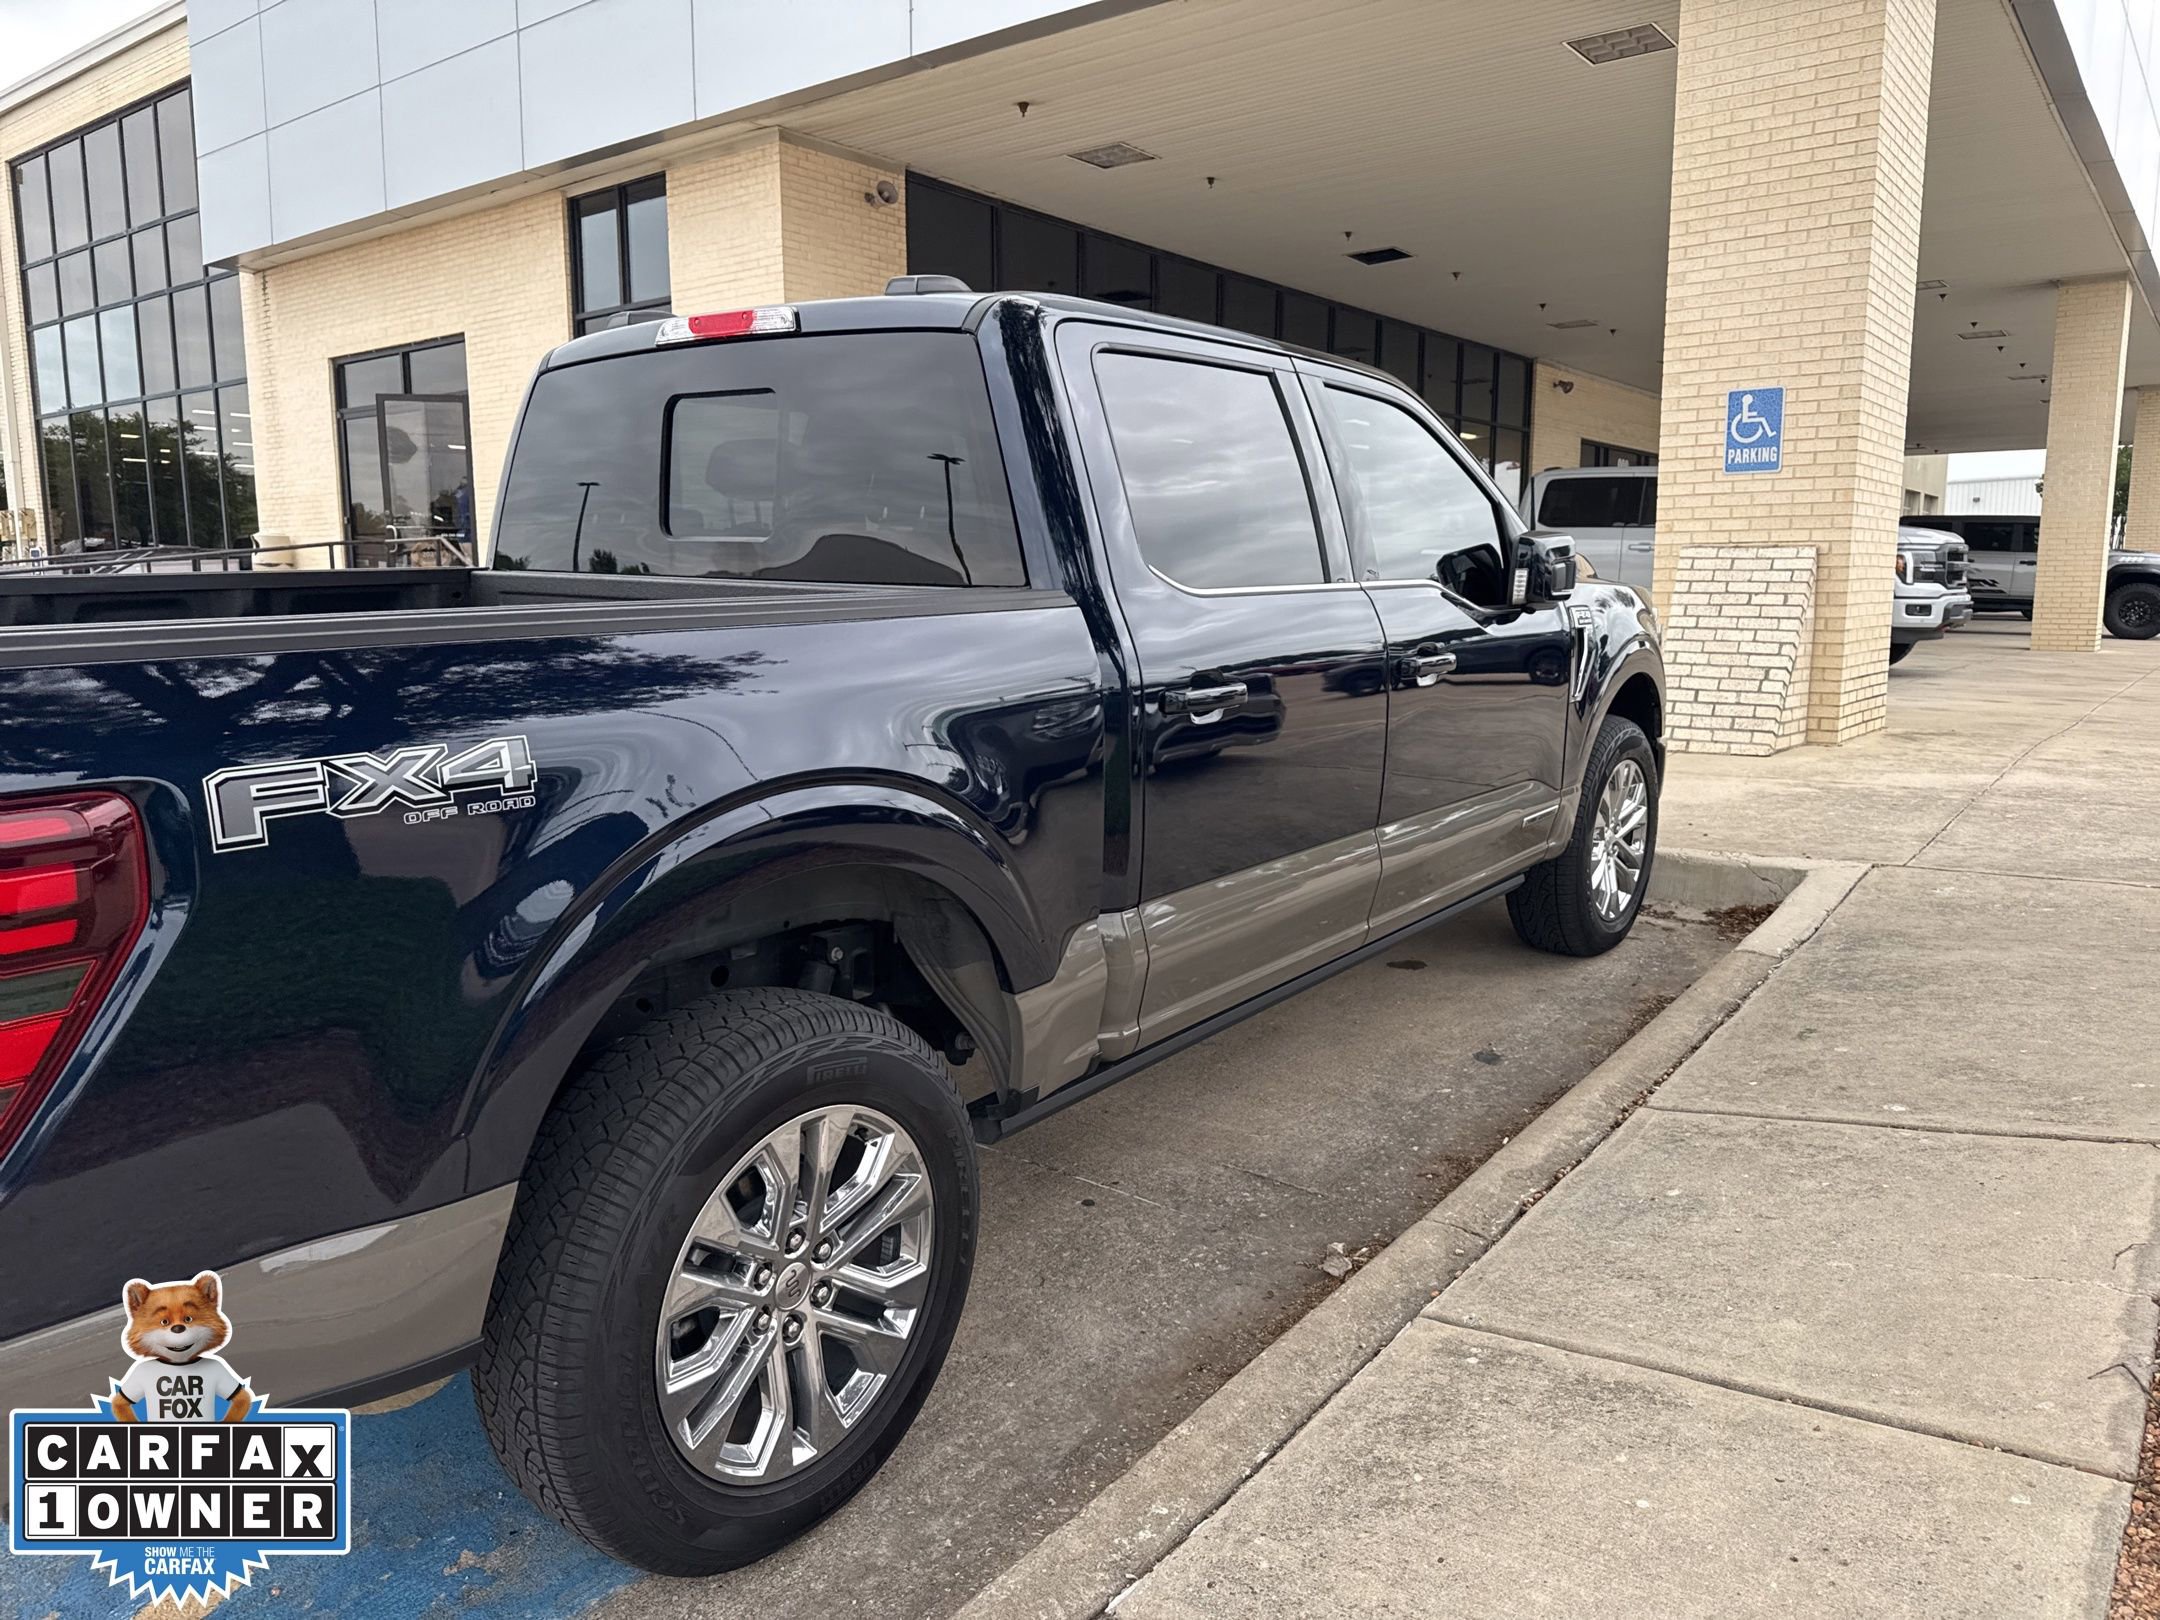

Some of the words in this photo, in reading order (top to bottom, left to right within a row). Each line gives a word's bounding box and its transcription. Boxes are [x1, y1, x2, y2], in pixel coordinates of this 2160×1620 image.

[1727, 446, 1778, 465] PARKING
[203, 735, 538, 854] FX4
[403, 806, 459, 825] OFF
[467, 795, 536, 816] ROAD
[807, 1056, 867, 1085] PIRELLI
